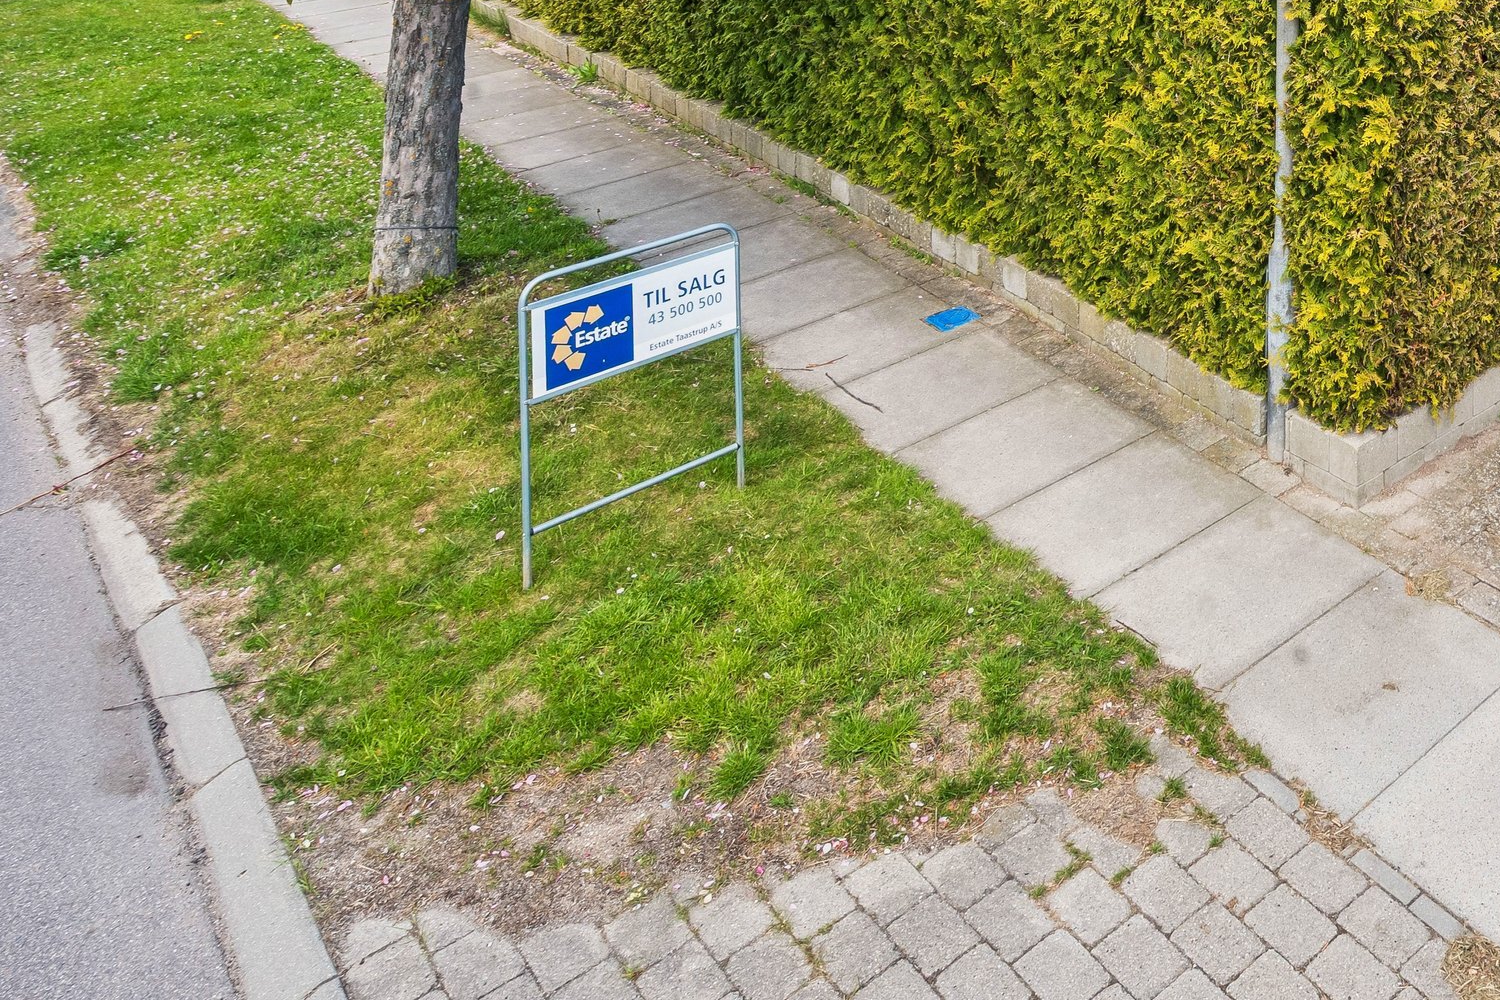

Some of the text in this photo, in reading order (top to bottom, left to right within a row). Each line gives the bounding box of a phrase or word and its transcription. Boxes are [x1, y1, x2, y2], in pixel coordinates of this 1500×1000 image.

[643, 269, 726, 308] TIL SALG
[648, 292, 722, 325] 43 500 500
[575, 320, 629, 348] Estate
[649, 320, 722, 351] Estate Taastrup A/S
